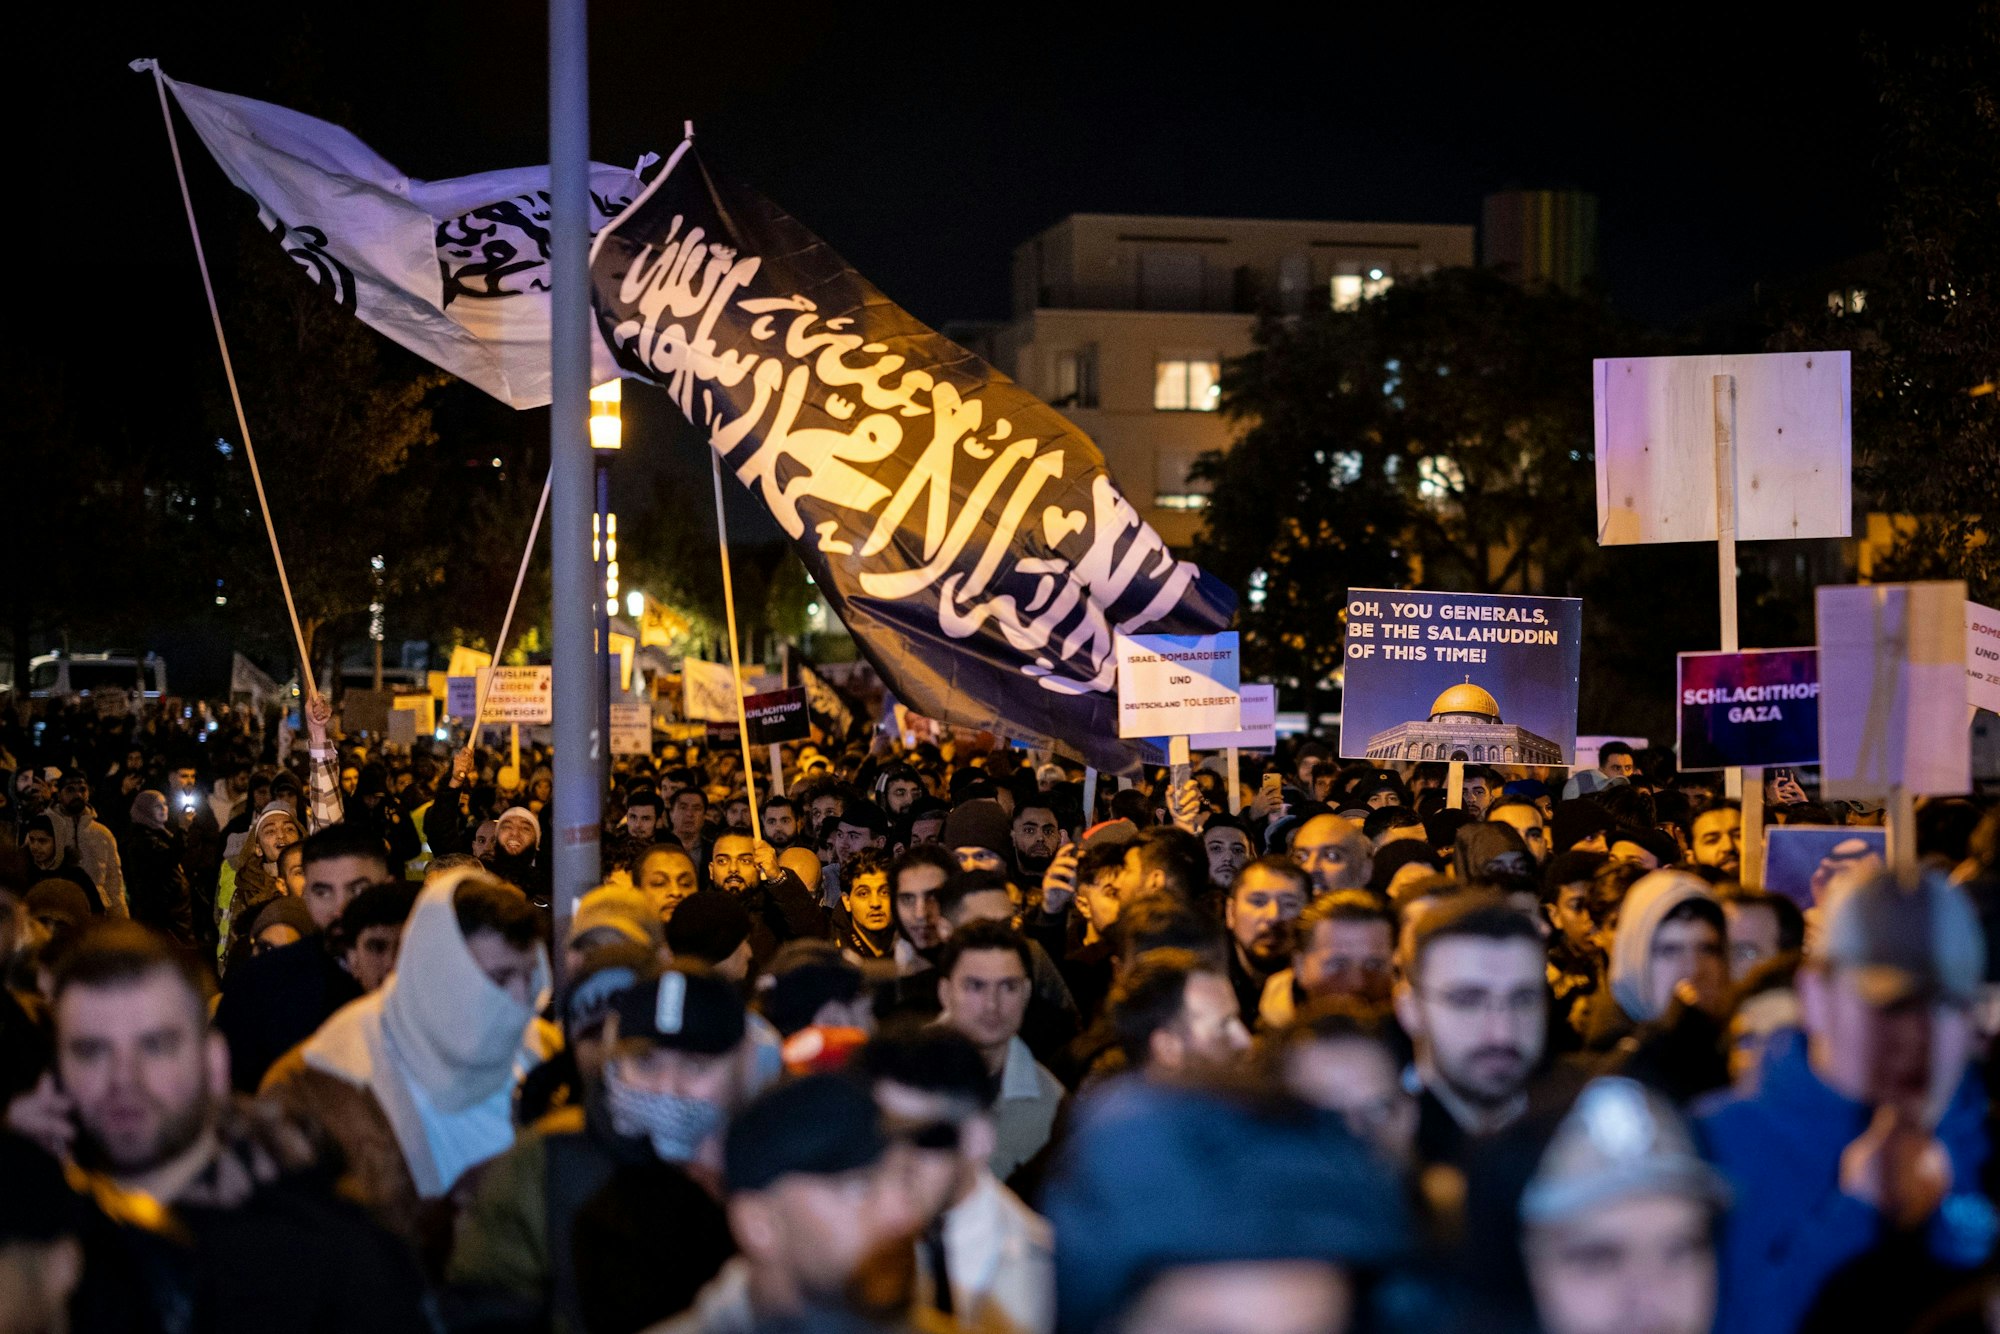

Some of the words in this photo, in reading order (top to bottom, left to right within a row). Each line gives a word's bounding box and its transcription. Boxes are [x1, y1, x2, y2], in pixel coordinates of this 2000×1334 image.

[1349, 601, 1383, 619] OH,
[1390, 602, 1433, 619] YOU
[1439, 604, 1549, 626] GENERALS,
[1348, 623, 1375, 638] BE
[1381, 623, 1420, 640] THE
[1427, 625, 1559, 645] SALAHUDDIN
[1127, 654, 1158, 664] ISRAEL
[1160, 650, 1232, 662] BOMBARDIERT
[1347, 643, 1375, 659] OF
[1382, 644, 1427, 661] THIS
[1434, 646, 1487, 664] TIME!
[1974, 646, 2000, 662] UND
[1169, 675, 1192, 685] UND
[1683, 682, 1820, 706] SCHLACHTHOF
[745, 702, 802, 718] CHLACHTHOF
[1125, 701, 1181, 710] DEUTSCHLAND
[1183, 696, 1237, 707] TOLERIERT
[1727, 705, 1783, 724] GAZA
